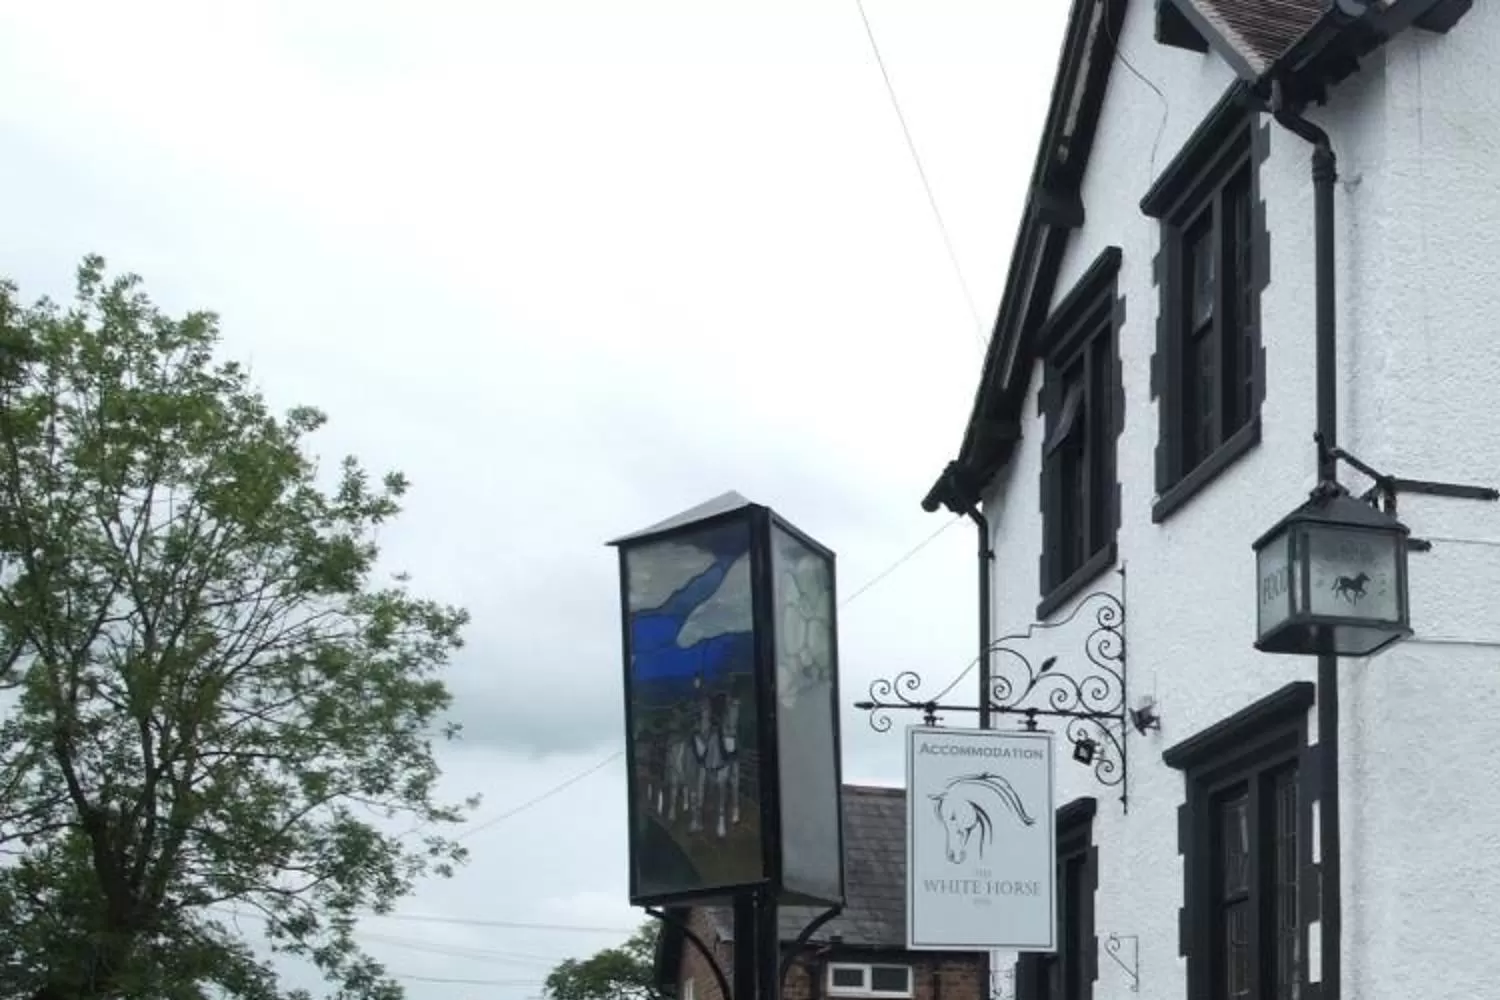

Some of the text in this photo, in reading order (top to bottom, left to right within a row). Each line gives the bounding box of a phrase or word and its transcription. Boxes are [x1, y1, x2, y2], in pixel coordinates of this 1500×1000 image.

[919, 743, 1043, 760] ACCOMMODATION
[923, 879, 1041, 896] WHITE HORSE
